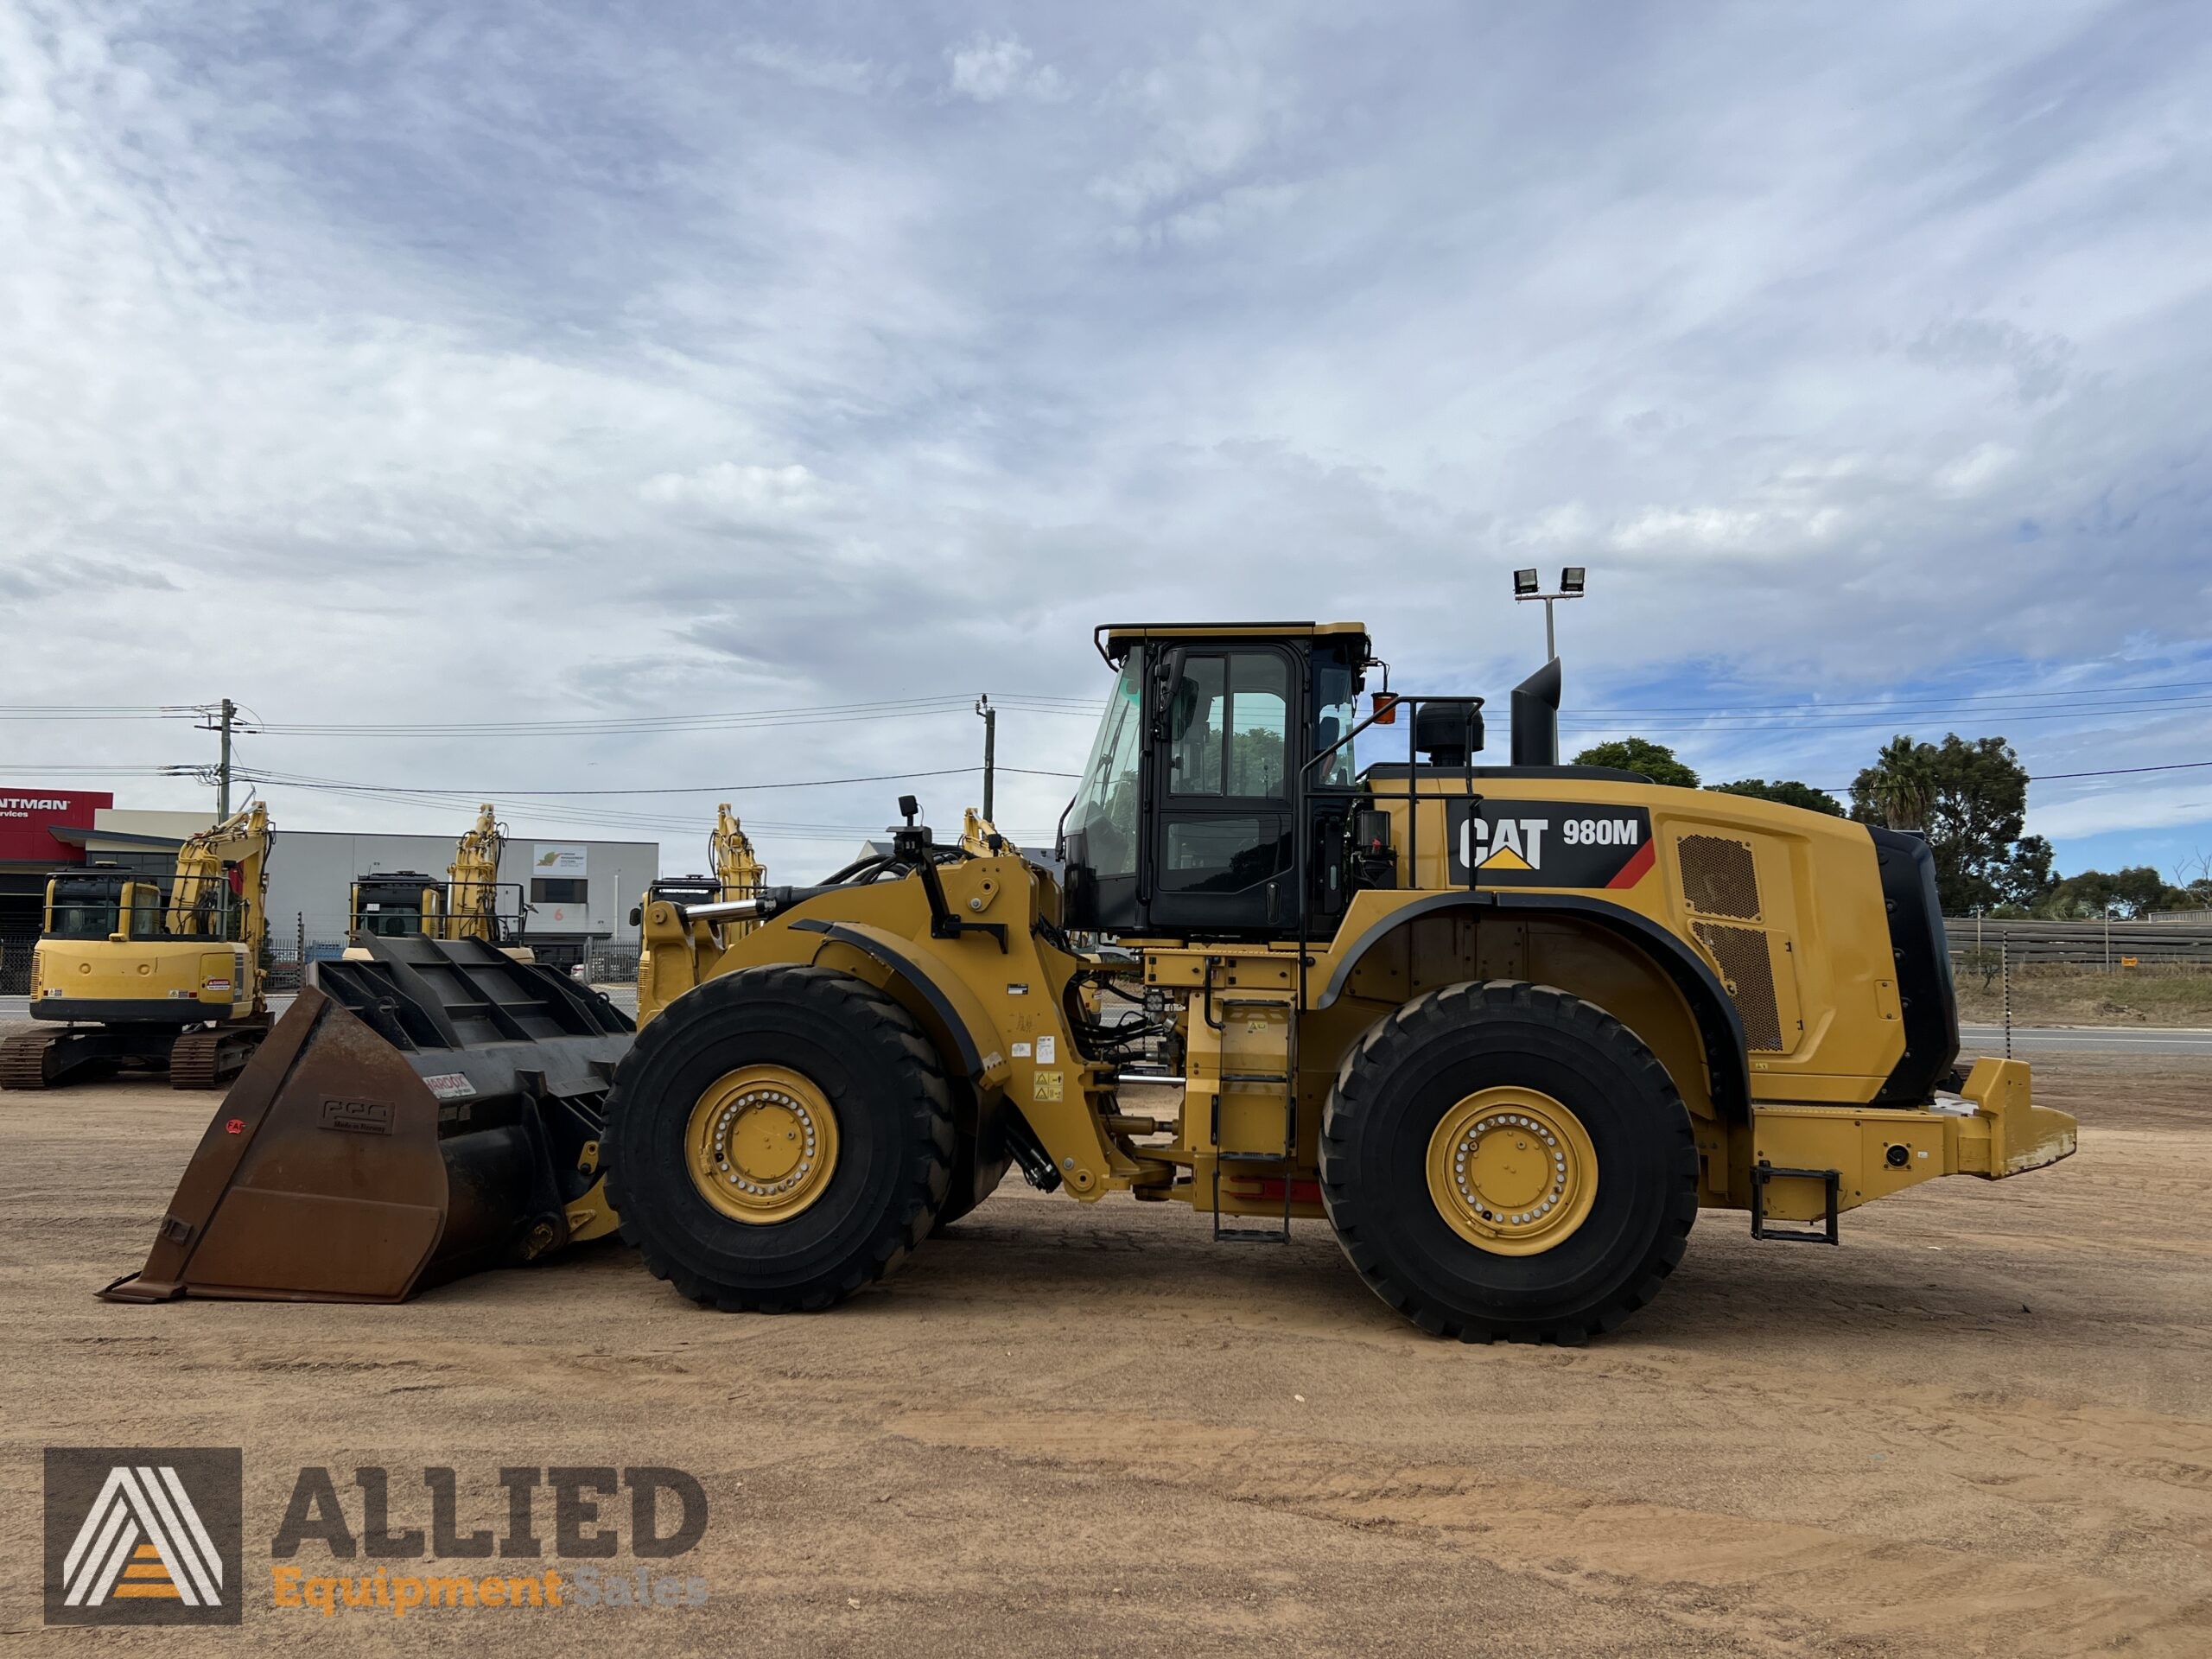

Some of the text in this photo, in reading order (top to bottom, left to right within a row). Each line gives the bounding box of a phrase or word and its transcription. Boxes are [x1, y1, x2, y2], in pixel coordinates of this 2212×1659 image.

[1459, 818, 1638, 869] CAT 980M
[554, 908, 564, 921] 6
